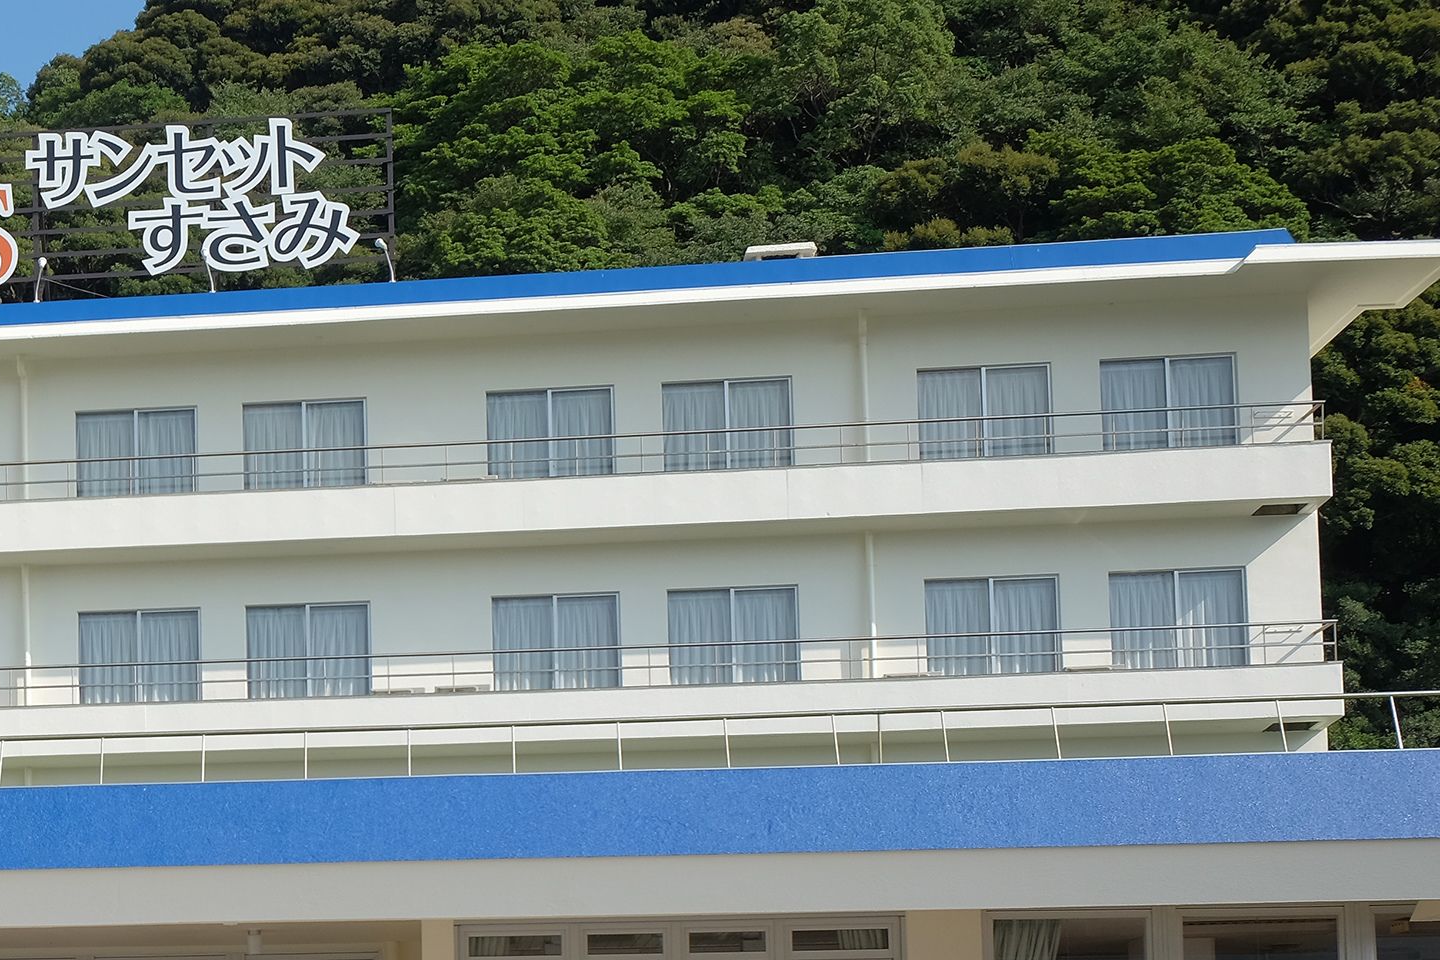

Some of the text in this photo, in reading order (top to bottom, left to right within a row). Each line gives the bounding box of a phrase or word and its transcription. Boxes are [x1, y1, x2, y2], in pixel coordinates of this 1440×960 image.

[27, 118, 325, 208] サンセット
[129, 192, 359, 275] すさみ
